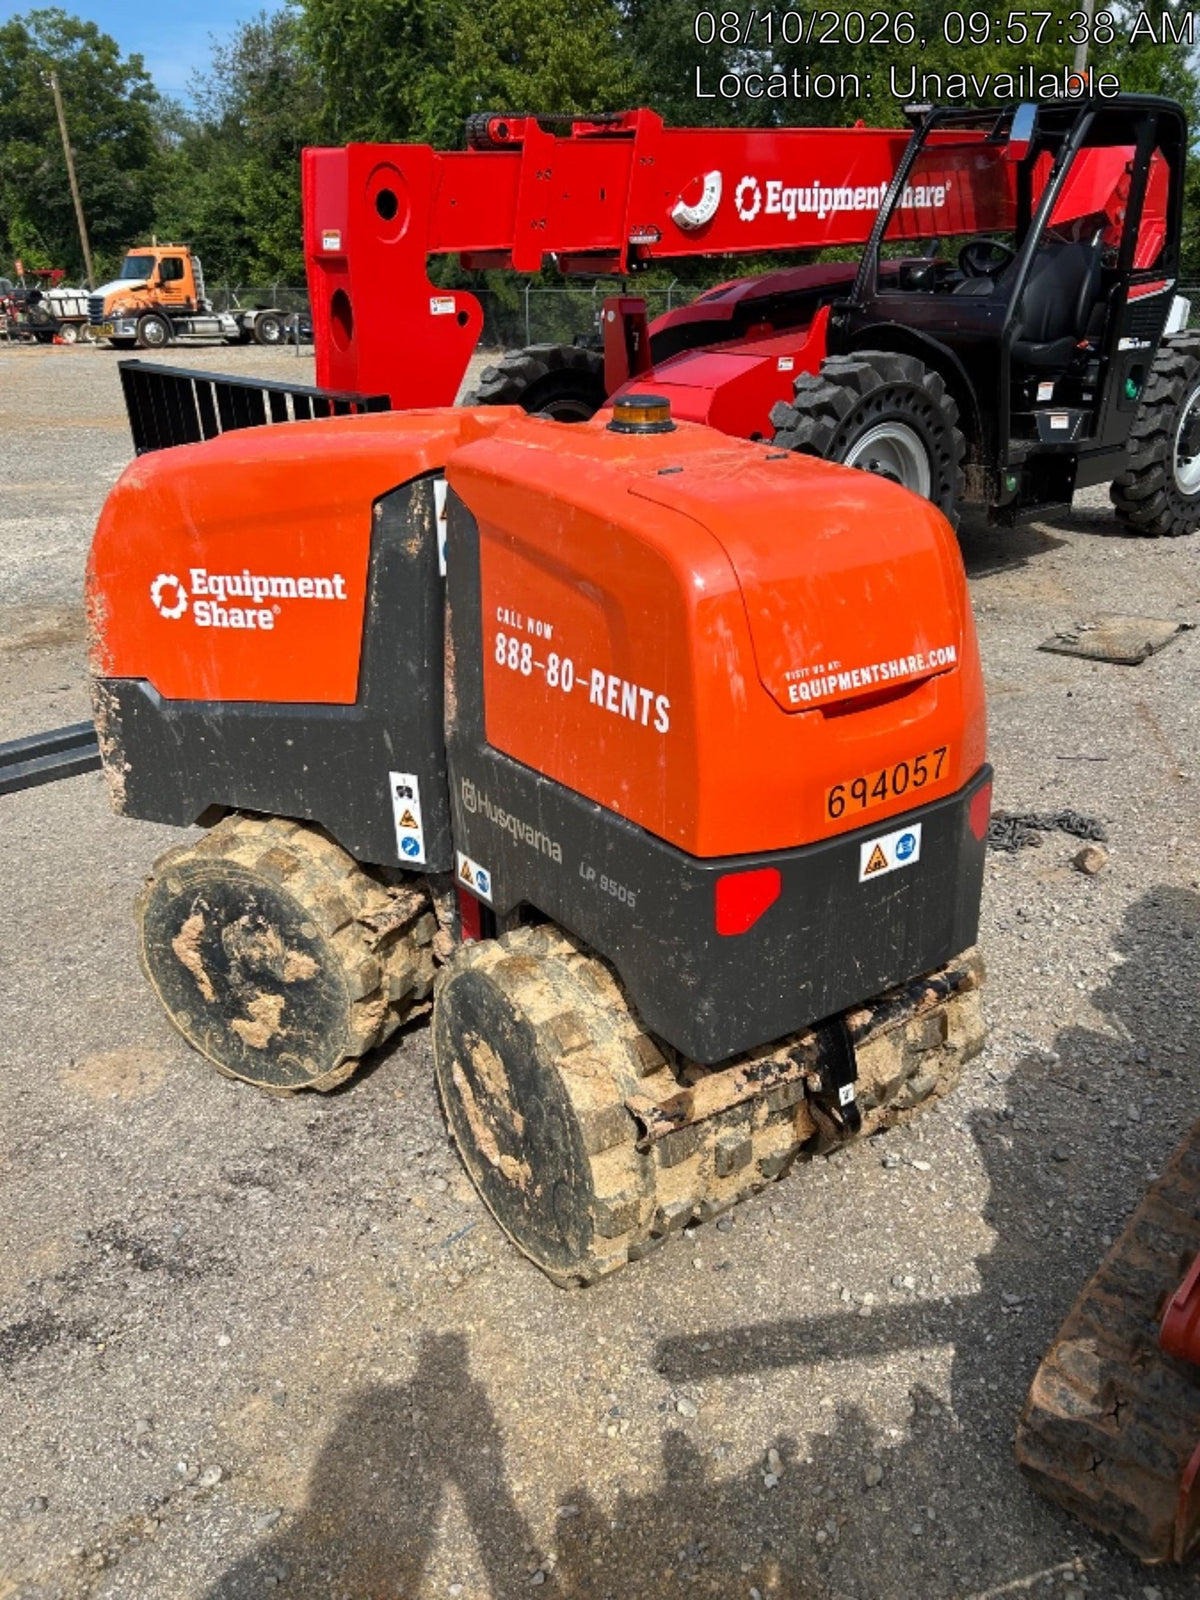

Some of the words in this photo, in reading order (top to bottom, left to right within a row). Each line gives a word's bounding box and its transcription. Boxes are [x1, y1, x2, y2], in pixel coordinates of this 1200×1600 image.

[189, 568, 348, 603] Equipment
[496, 606, 524, 630] CALL
[527, 616, 554, 640] NOW
[494, 632, 671, 734] 888-80-RENTS
[785, 667, 810, 681] VISIT
[788, 645, 957, 704] EQUIPMENTSHARE.COM
[827, 746, 947, 819] 694057
[477, 790, 563, 865] Husqvarna
